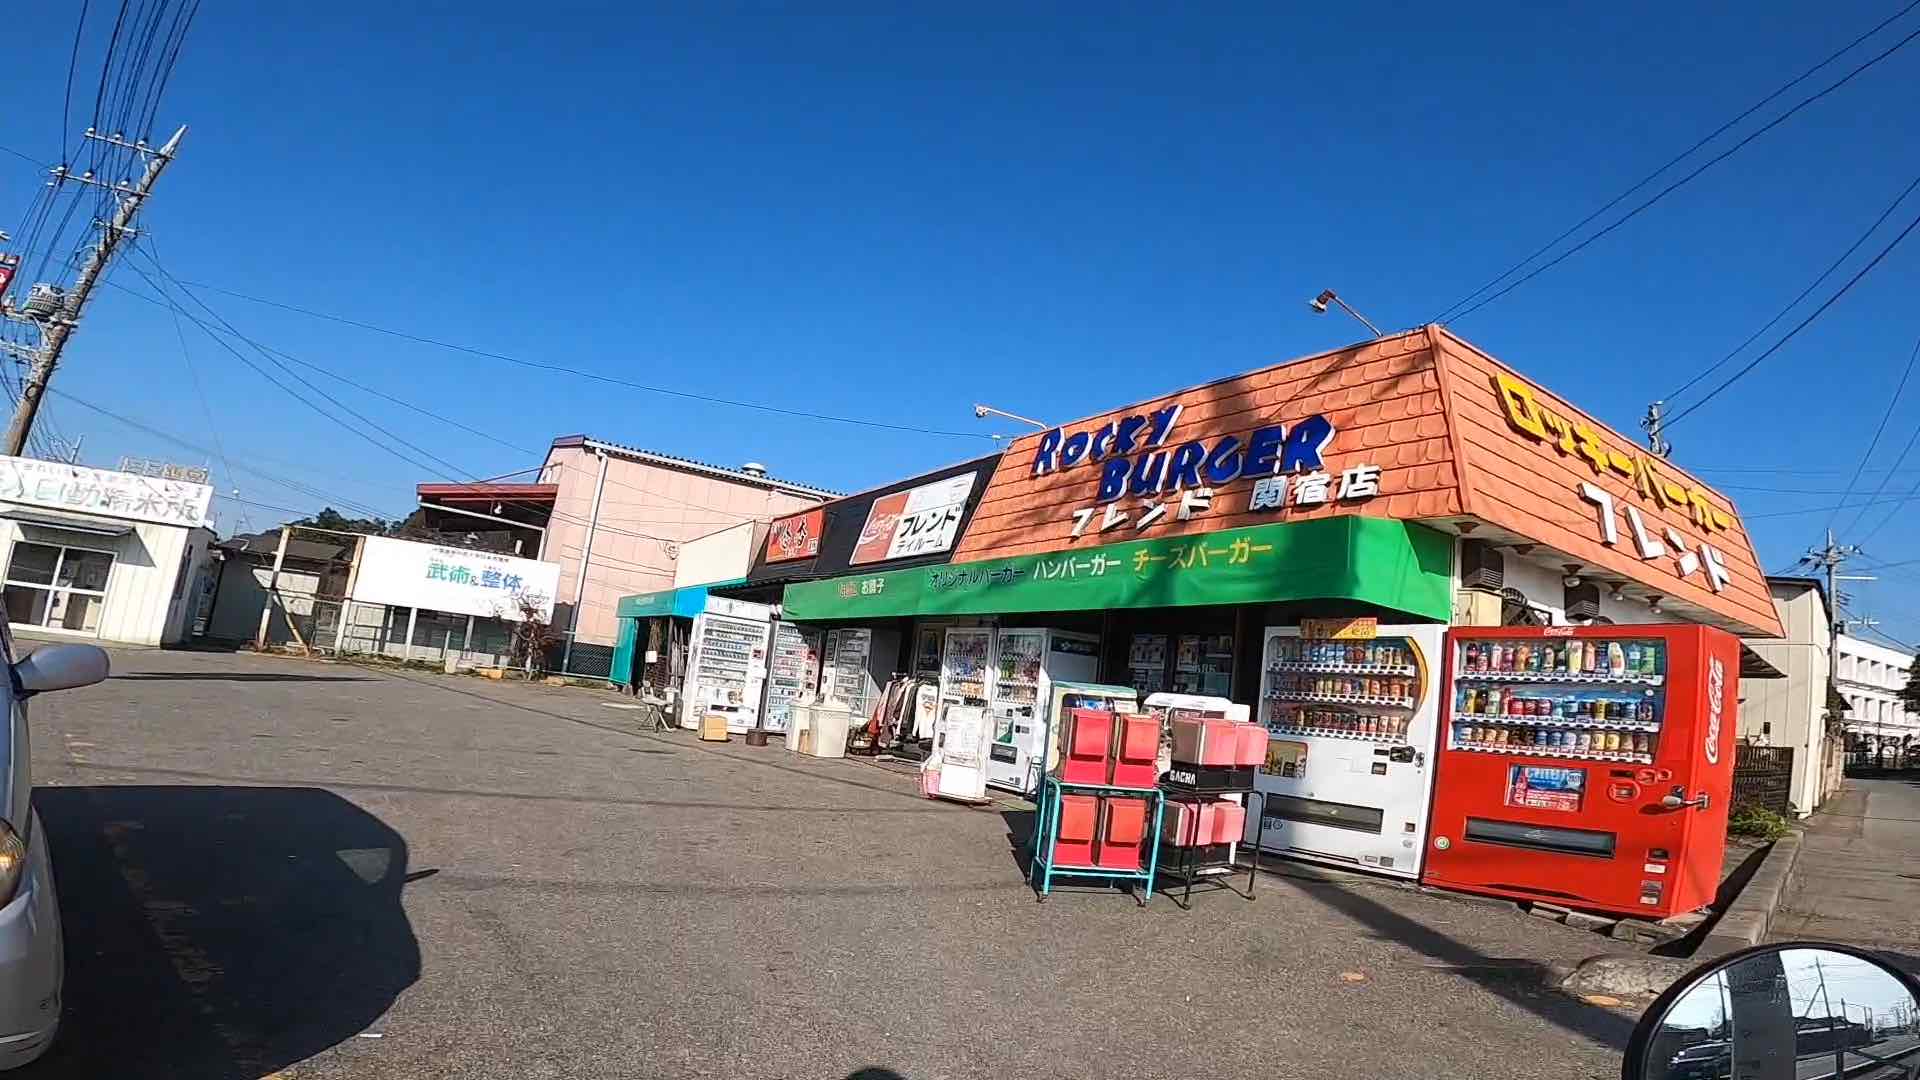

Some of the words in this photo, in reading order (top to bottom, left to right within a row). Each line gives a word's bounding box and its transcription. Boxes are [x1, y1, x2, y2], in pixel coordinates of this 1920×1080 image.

[1098, 414, 1337, 504] BURGER
[899, 506, 961, 538] フレンド
[1071, 486, 1215, 538] フレンド
[1249, 463, 1382, 511] 関宿店
[1576, 482, 1732, 593] フレンド
[1033, 552, 1121, 580] ハンバーガー
[1132, 536, 1273, 572] チーズバーガー
[1704, 649, 1724, 764] Coca-Cola
